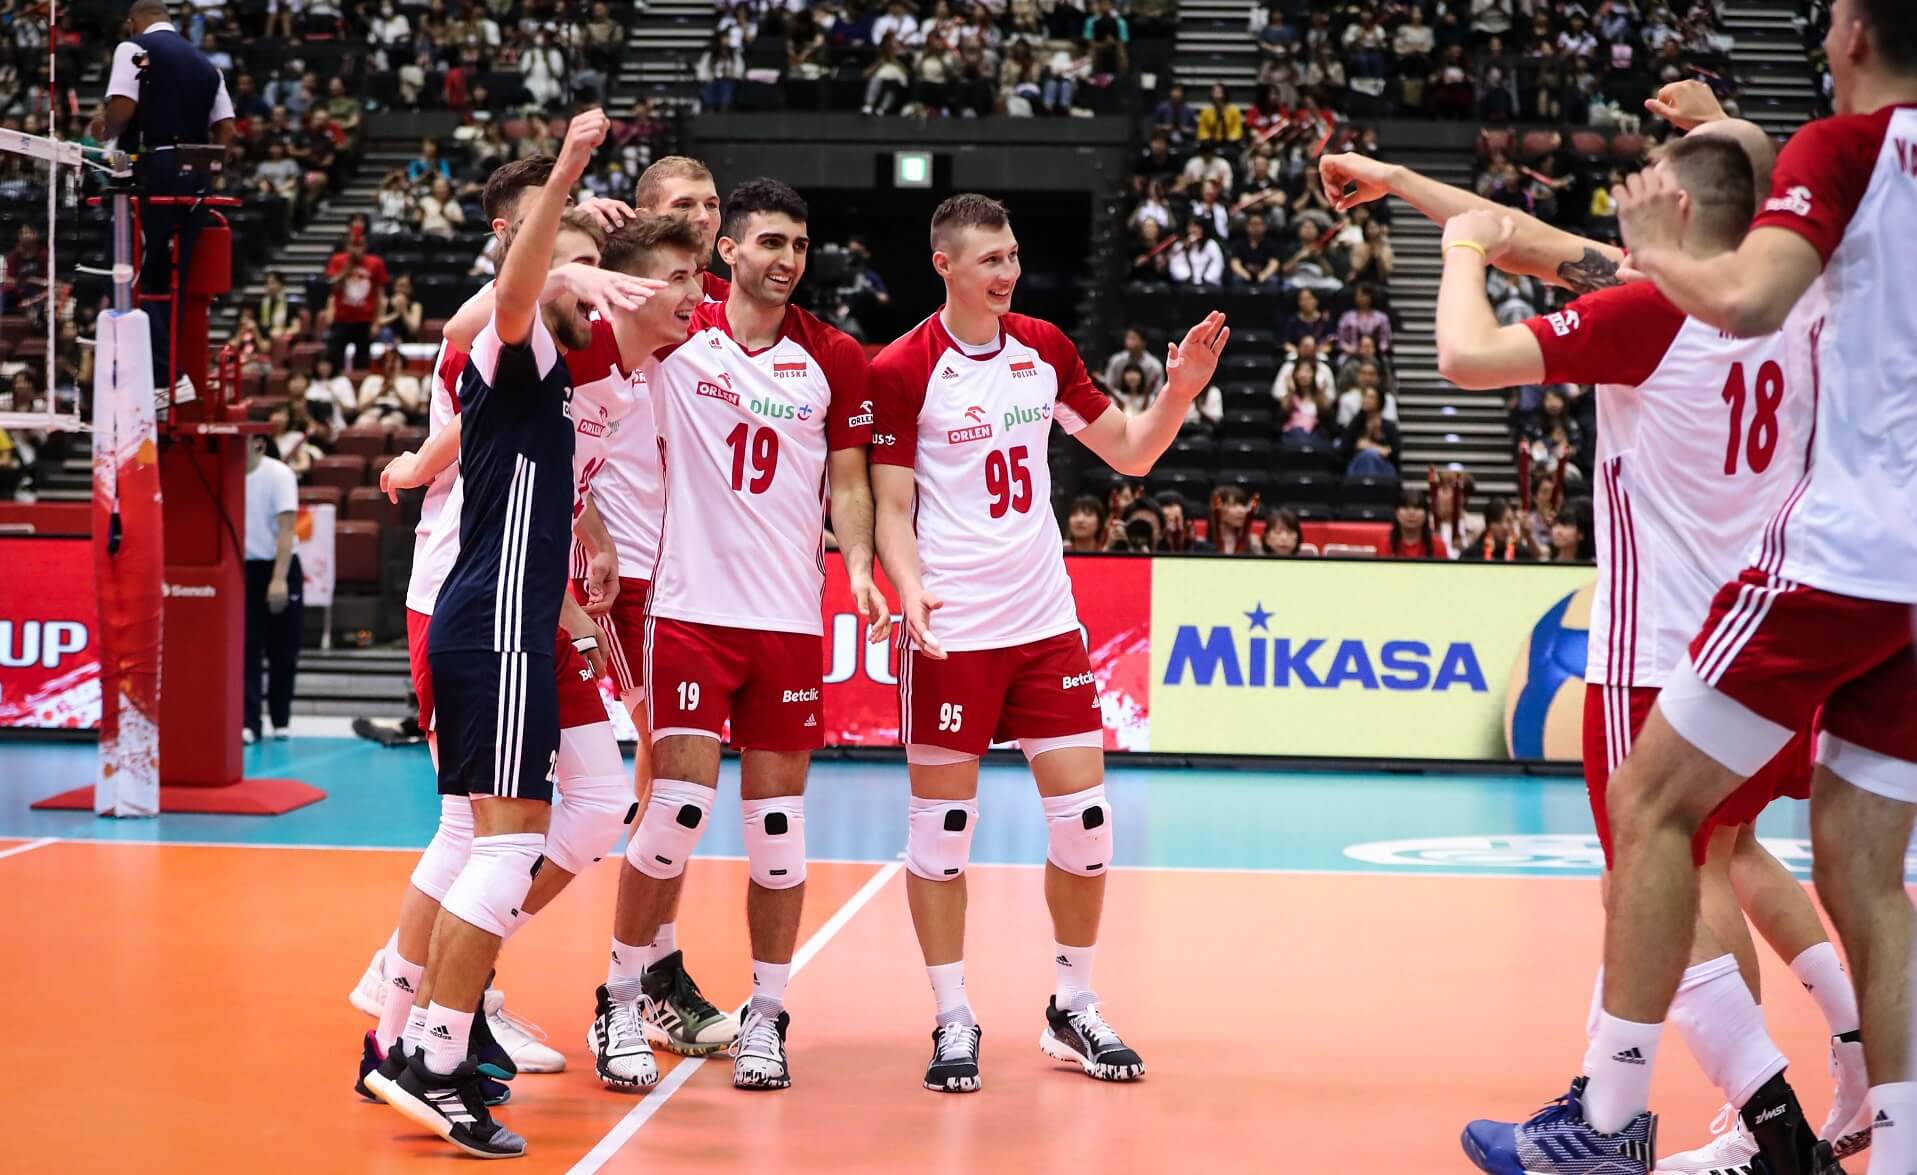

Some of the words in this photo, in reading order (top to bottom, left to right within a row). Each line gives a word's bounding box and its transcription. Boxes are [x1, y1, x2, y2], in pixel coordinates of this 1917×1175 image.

[773, 370, 807, 378] POLSKA
[1012, 370, 1038, 379] POLSKA
[700, 386, 738, 404] ORLEN
[751, 397, 795, 420] plus
[1004, 404, 1041, 432] plus
[1721, 360, 1785, 476] 18
[950, 426, 991, 442] ORLEN
[726, 422, 779, 495] 19
[985, 445, 1033, 519] 95
[1162, 624, 1490, 693] MIKASA
[676, 681, 700, 711] 19
[782, 687, 819, 703] Betclic
[938, 702, 963, 733] 95
